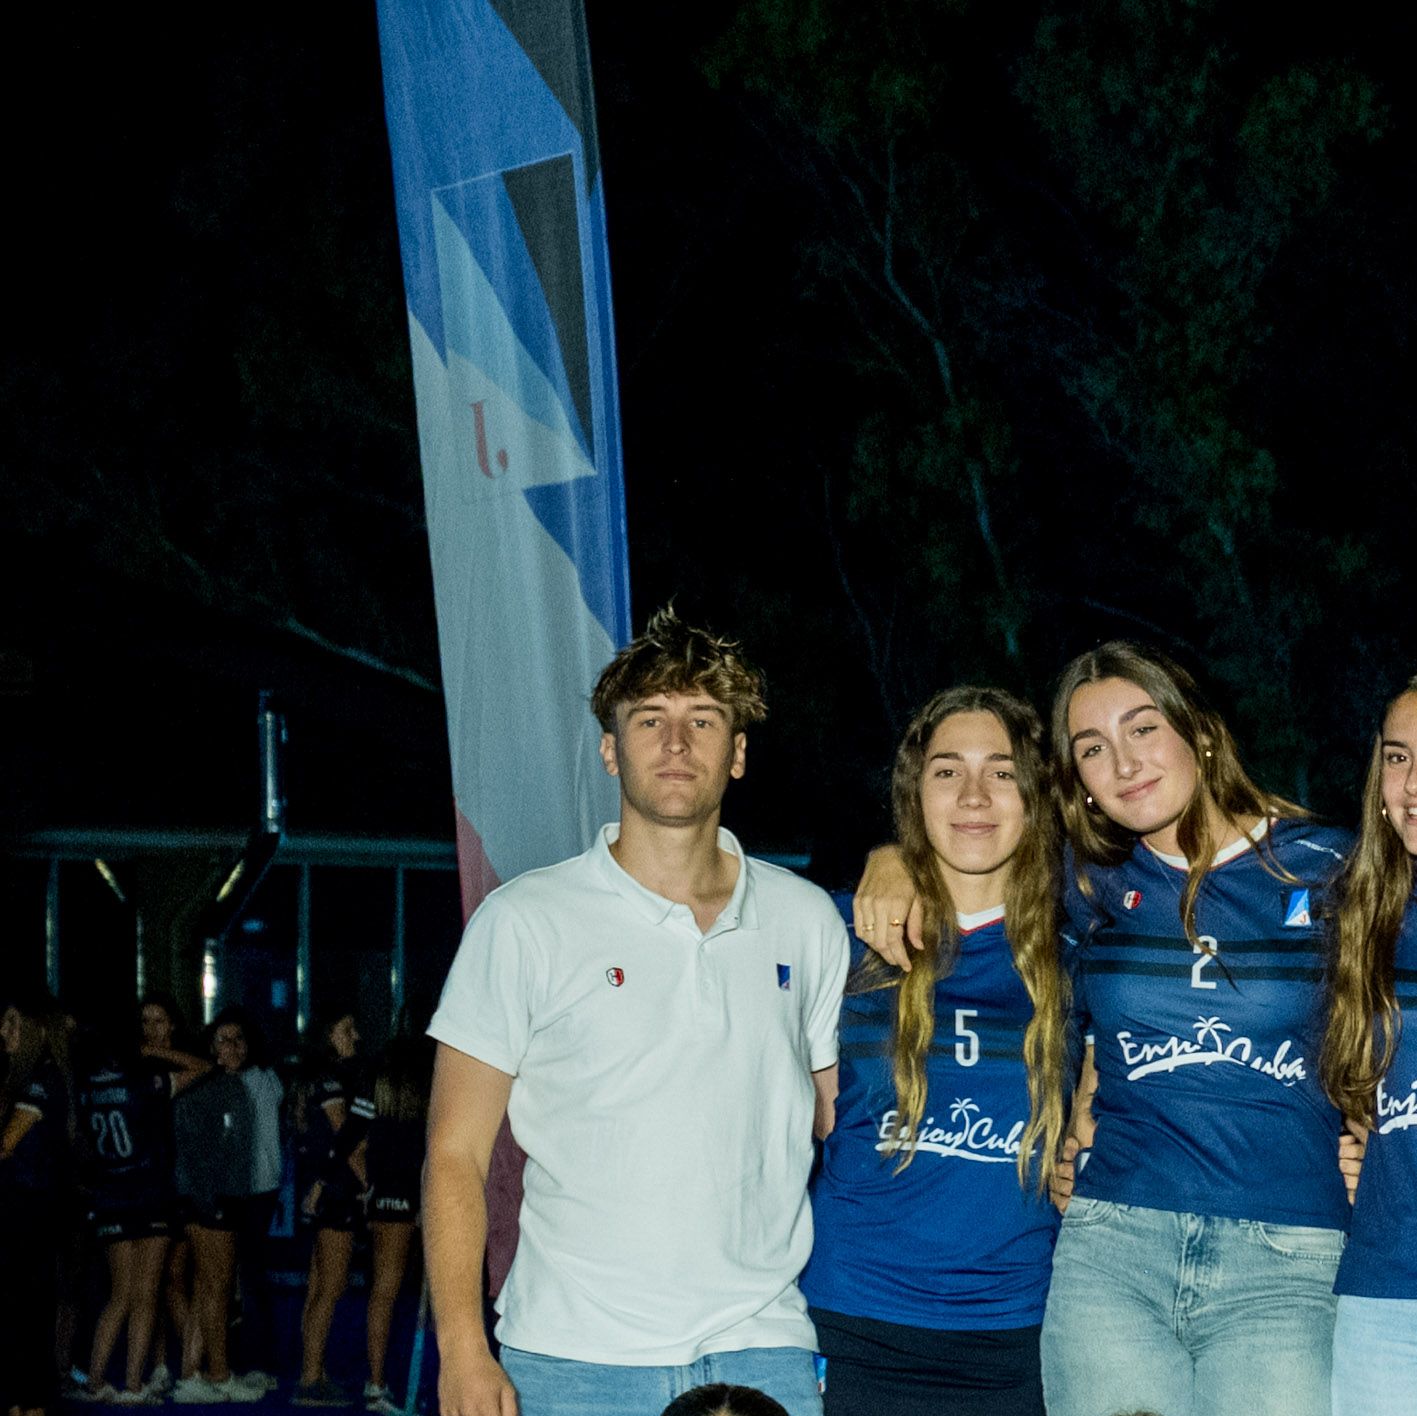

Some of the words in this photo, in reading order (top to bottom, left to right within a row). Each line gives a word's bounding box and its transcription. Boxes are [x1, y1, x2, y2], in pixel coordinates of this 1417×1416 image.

[1191, 935, 1217, 990] 2
[955, 1009, 979, 1067] 5
[90, 1109, 133, 1158] 20
